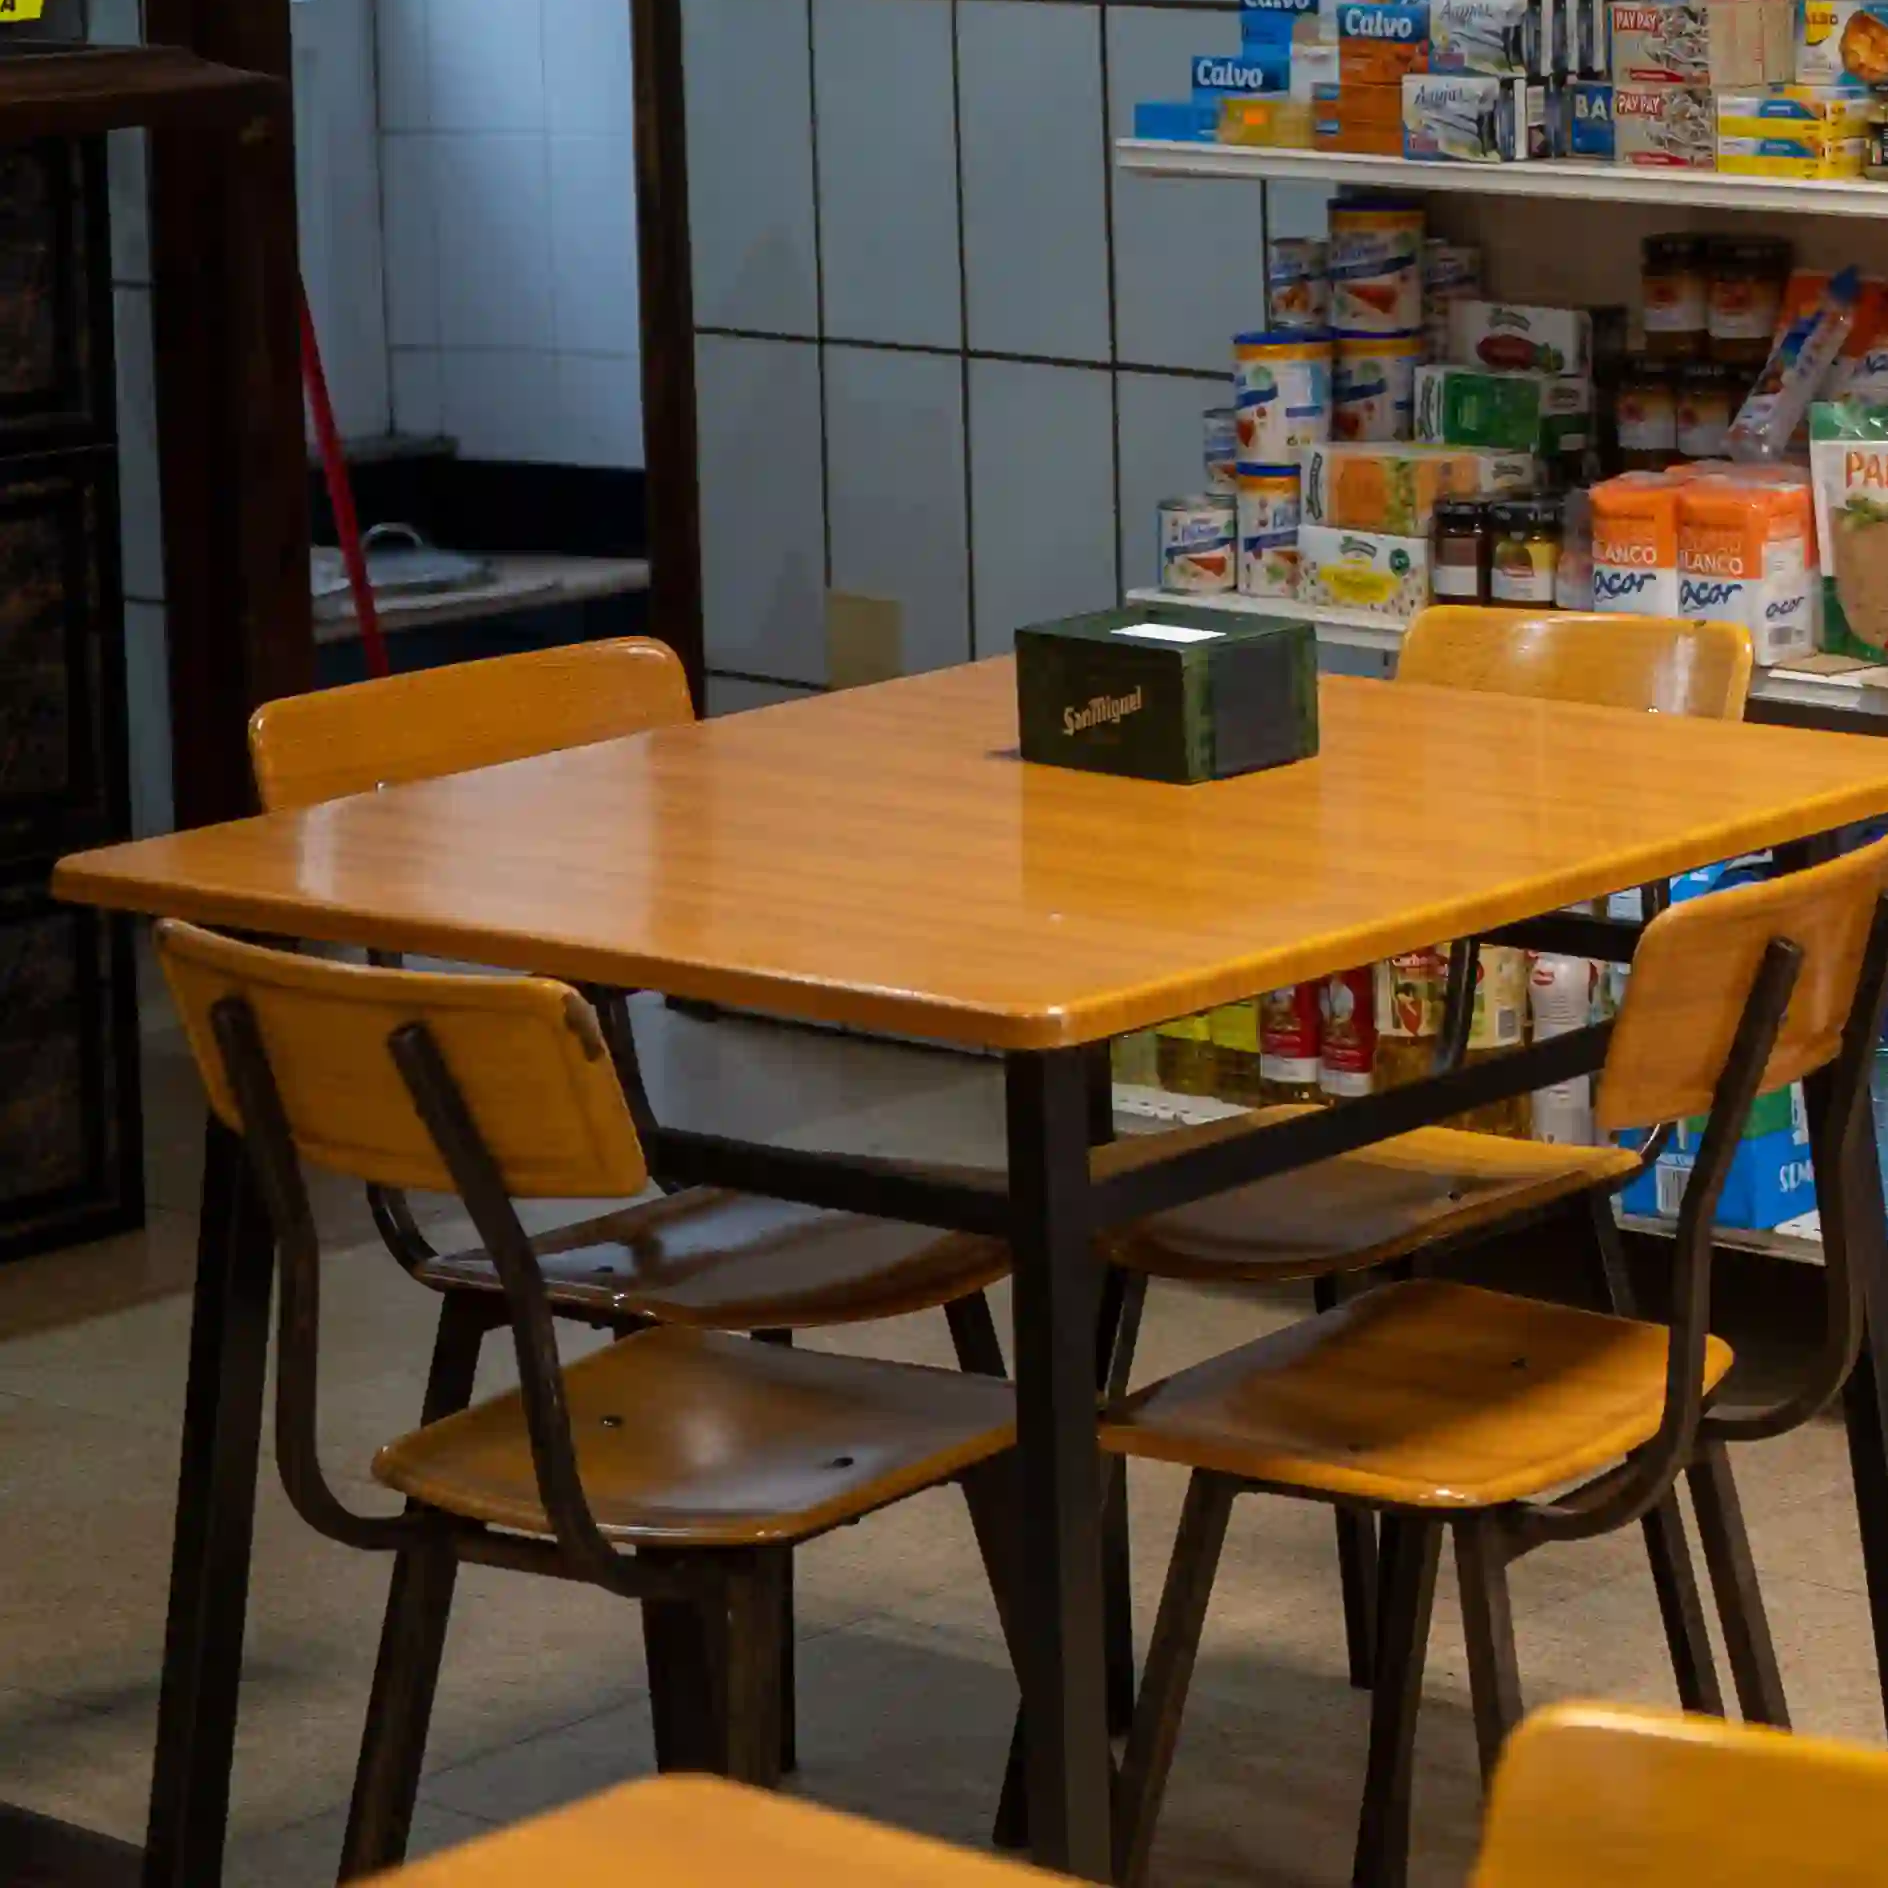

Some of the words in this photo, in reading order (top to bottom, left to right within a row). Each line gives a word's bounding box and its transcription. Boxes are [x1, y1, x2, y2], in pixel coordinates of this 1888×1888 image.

[1344, 10, 1413, 39] Calvo
[1196, 60, 1264, 90] Calvo
[1617, 92, 1638, 112] PAY
[1639, 93, 1659, 112] PAY
[1593, 545, 1657, 564] LANCO
[1593, 569, 1656, 597] acor
[1679, 582, 1743, 611] acor
